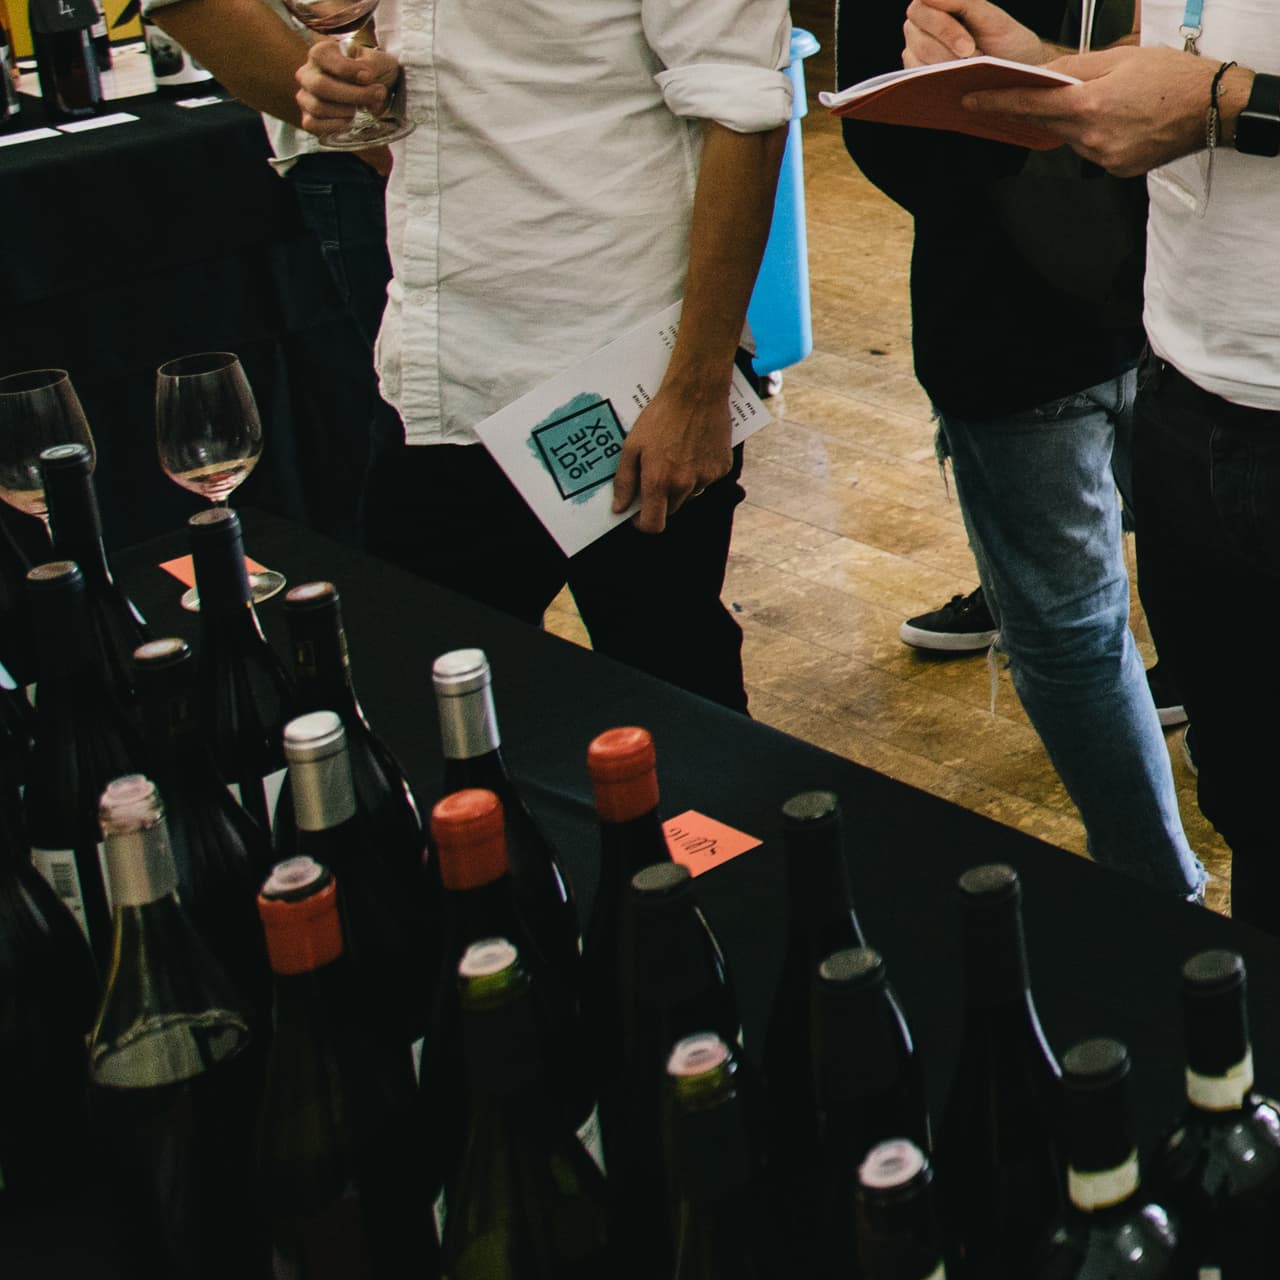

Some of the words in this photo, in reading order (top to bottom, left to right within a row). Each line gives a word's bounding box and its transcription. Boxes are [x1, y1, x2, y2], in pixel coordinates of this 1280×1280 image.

[58, 0, 75, 17] 4
[550, 442, 588, 480] OUT
[568, 428, 604, 470] THE
